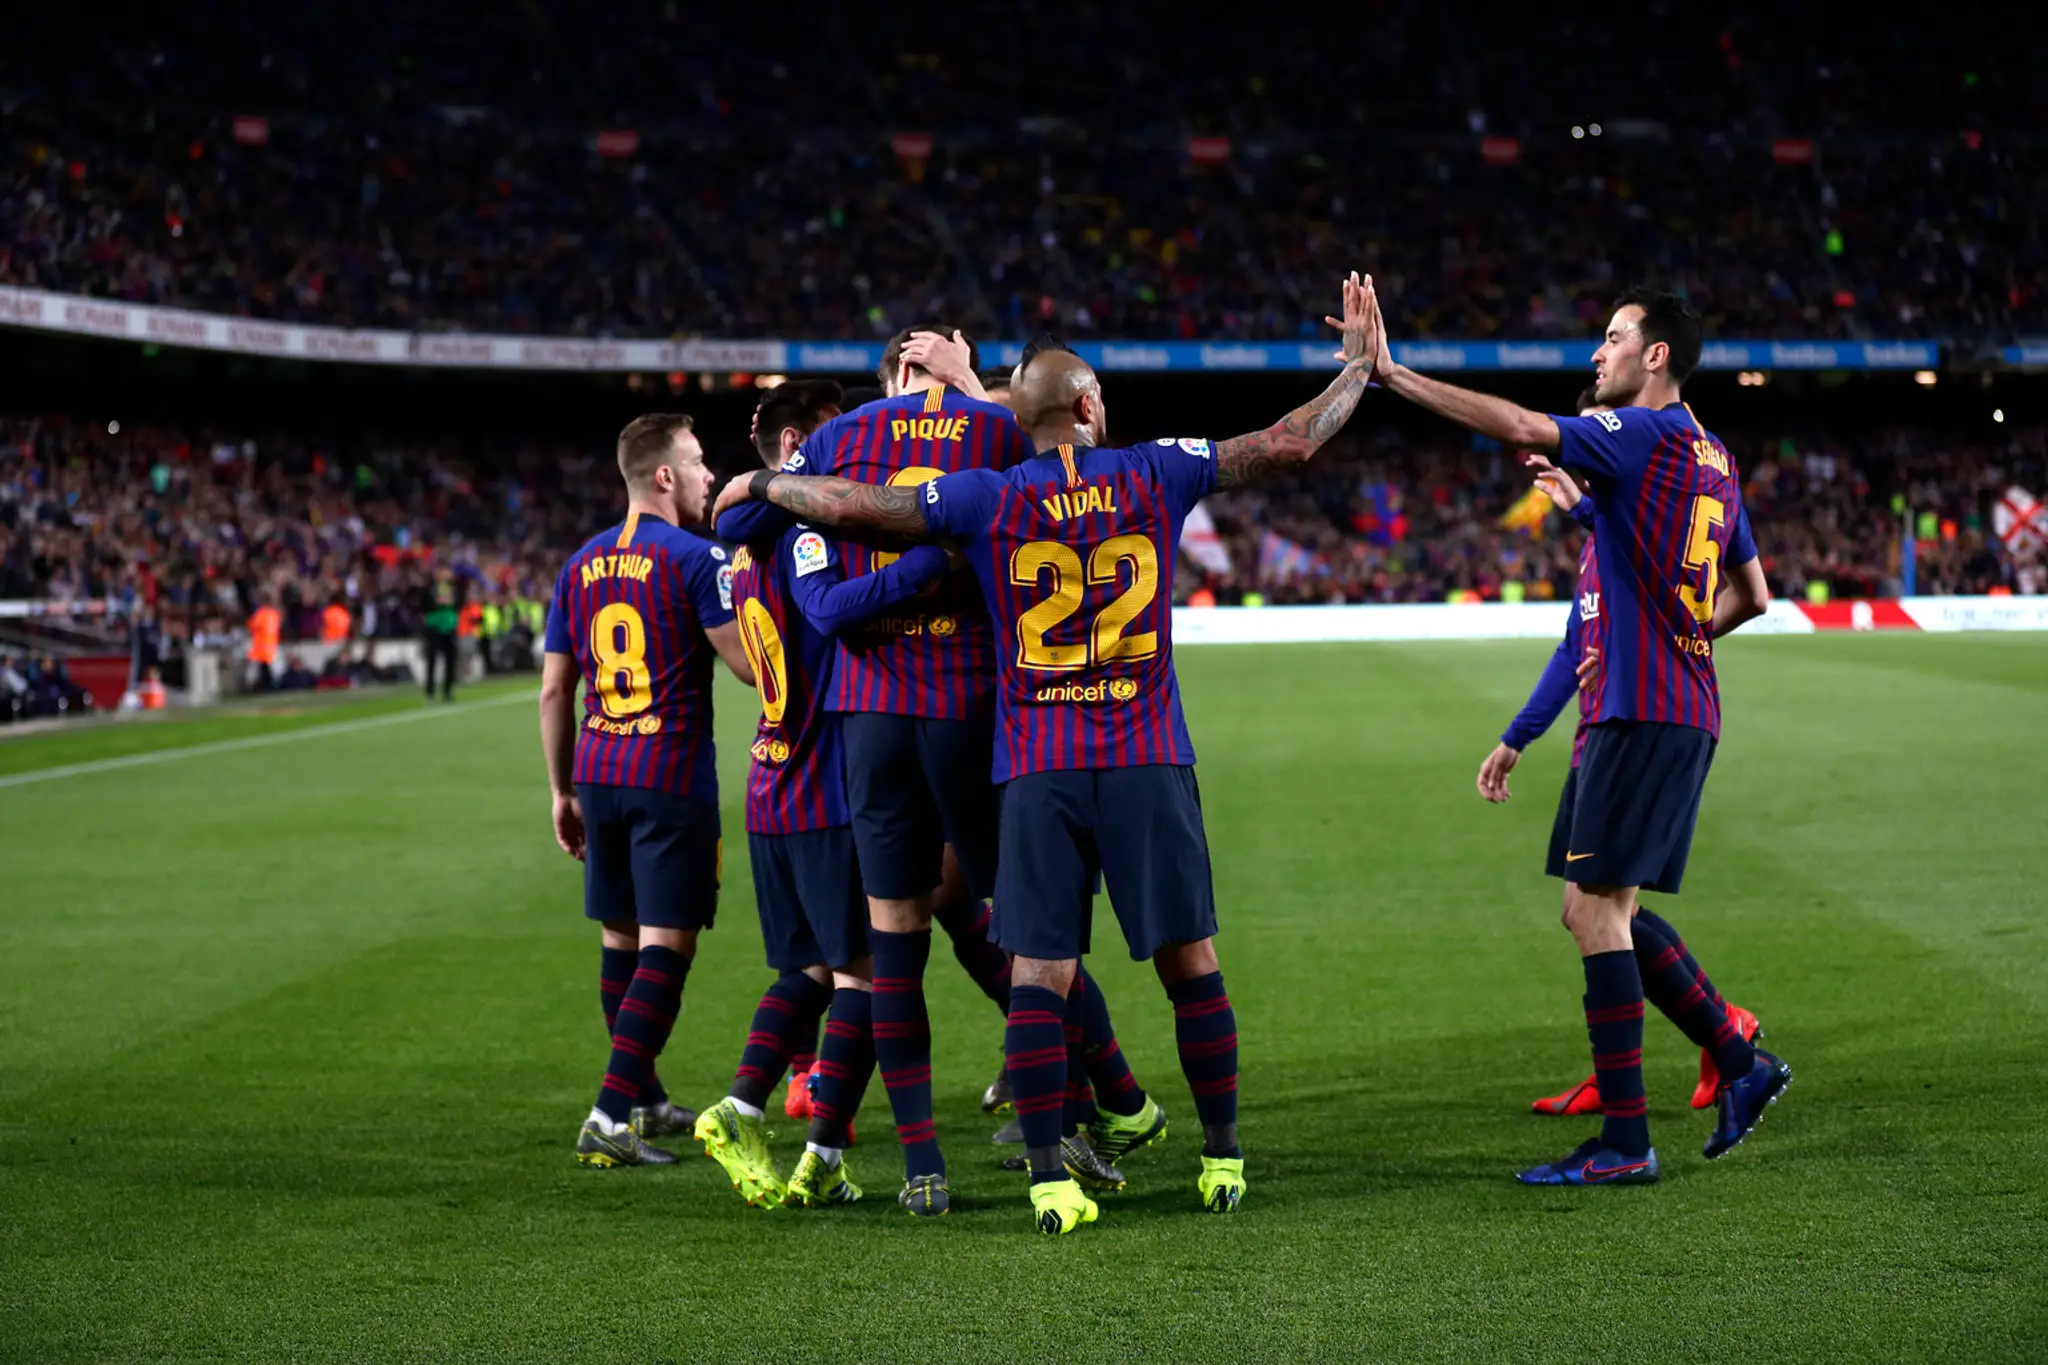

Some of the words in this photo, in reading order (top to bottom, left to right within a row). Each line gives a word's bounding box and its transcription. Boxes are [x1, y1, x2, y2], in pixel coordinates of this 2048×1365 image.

[891, 416, 970, 442] PIQUÉ
[1042, 485, 1117, 522] VIDAL
[581, 554, 654, 589] ARTHUR
[1675, 494, 1725, 624] 5
[1009, 533, 1159, 671] 22
[590, 602, 653, 718] 8
[1036, 680, 1107, 701] unicef
[587, 714, 638, 735] unicef
